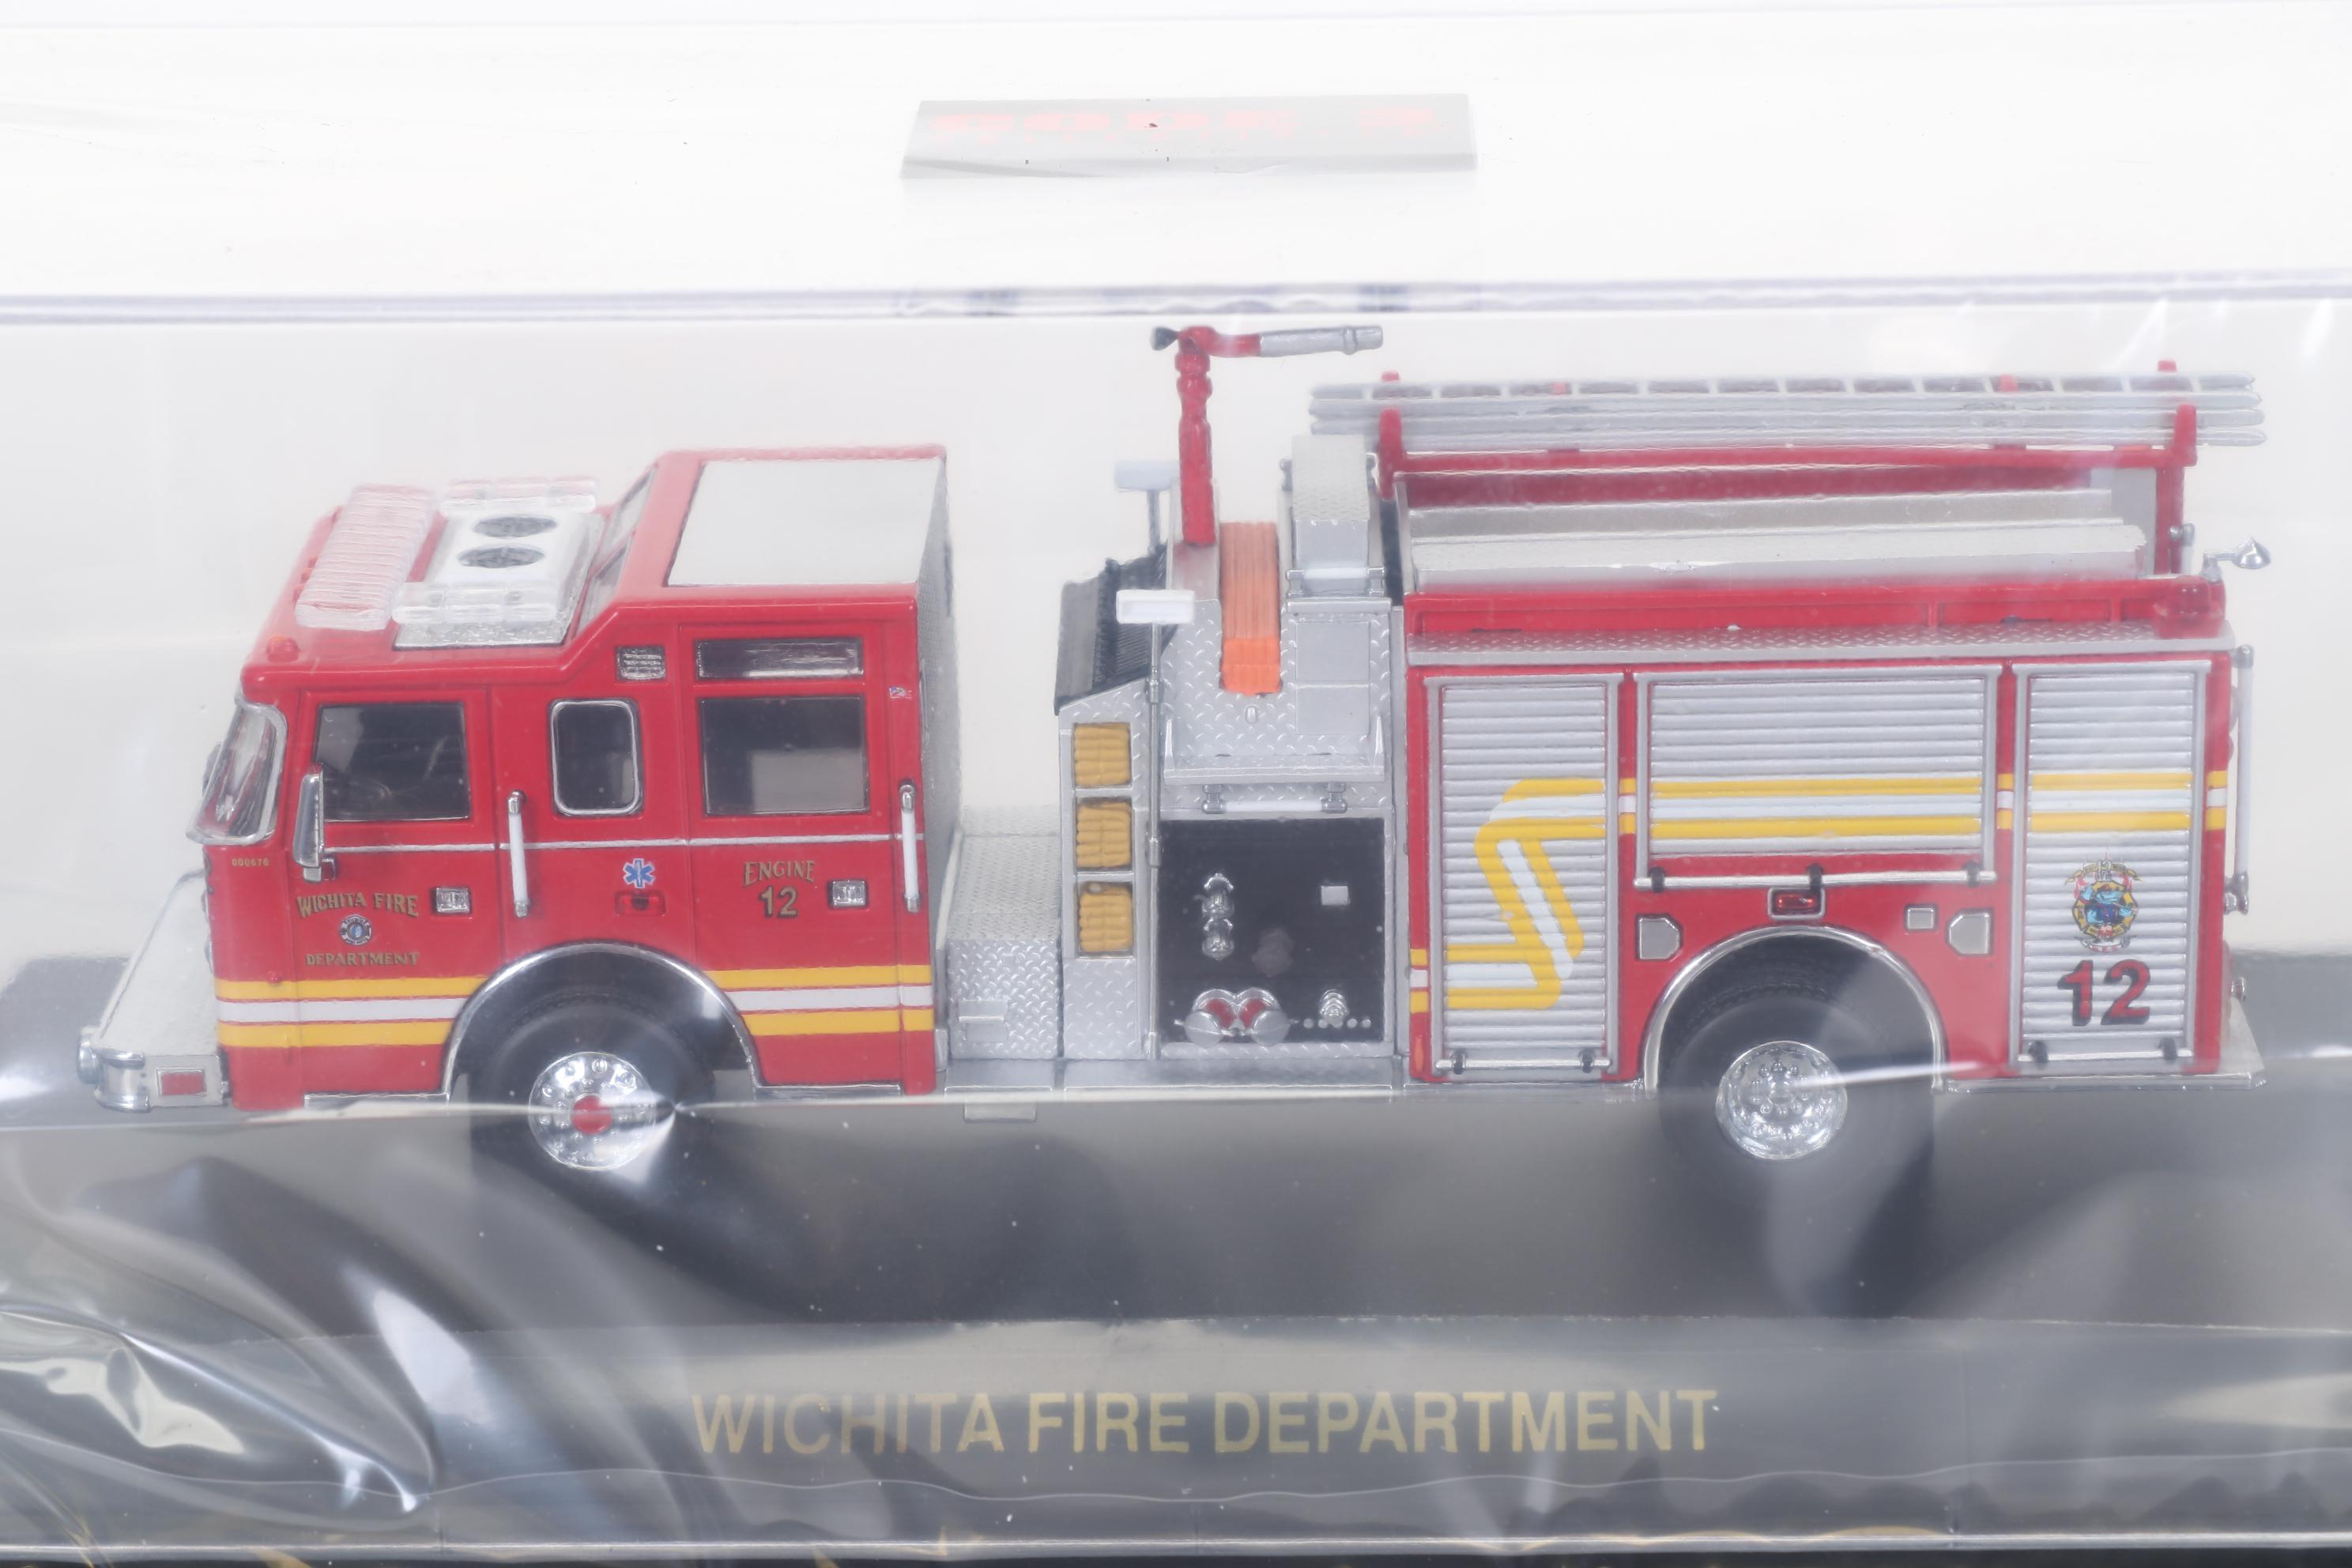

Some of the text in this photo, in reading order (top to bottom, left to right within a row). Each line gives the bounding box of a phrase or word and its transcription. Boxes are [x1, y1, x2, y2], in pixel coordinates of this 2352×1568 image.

[744, 860, 816, 886] ENGINE
[297, 892, 420, 918] WICHITA FIRE
[760, 886, 798, 918] 12
[305, 952, 420, 966] DEPARTMENT
[2057, 959, 2150, 1026] 12
[692, 1389, 1717, 1455] WICHITA FIRE DEPARTMENT
